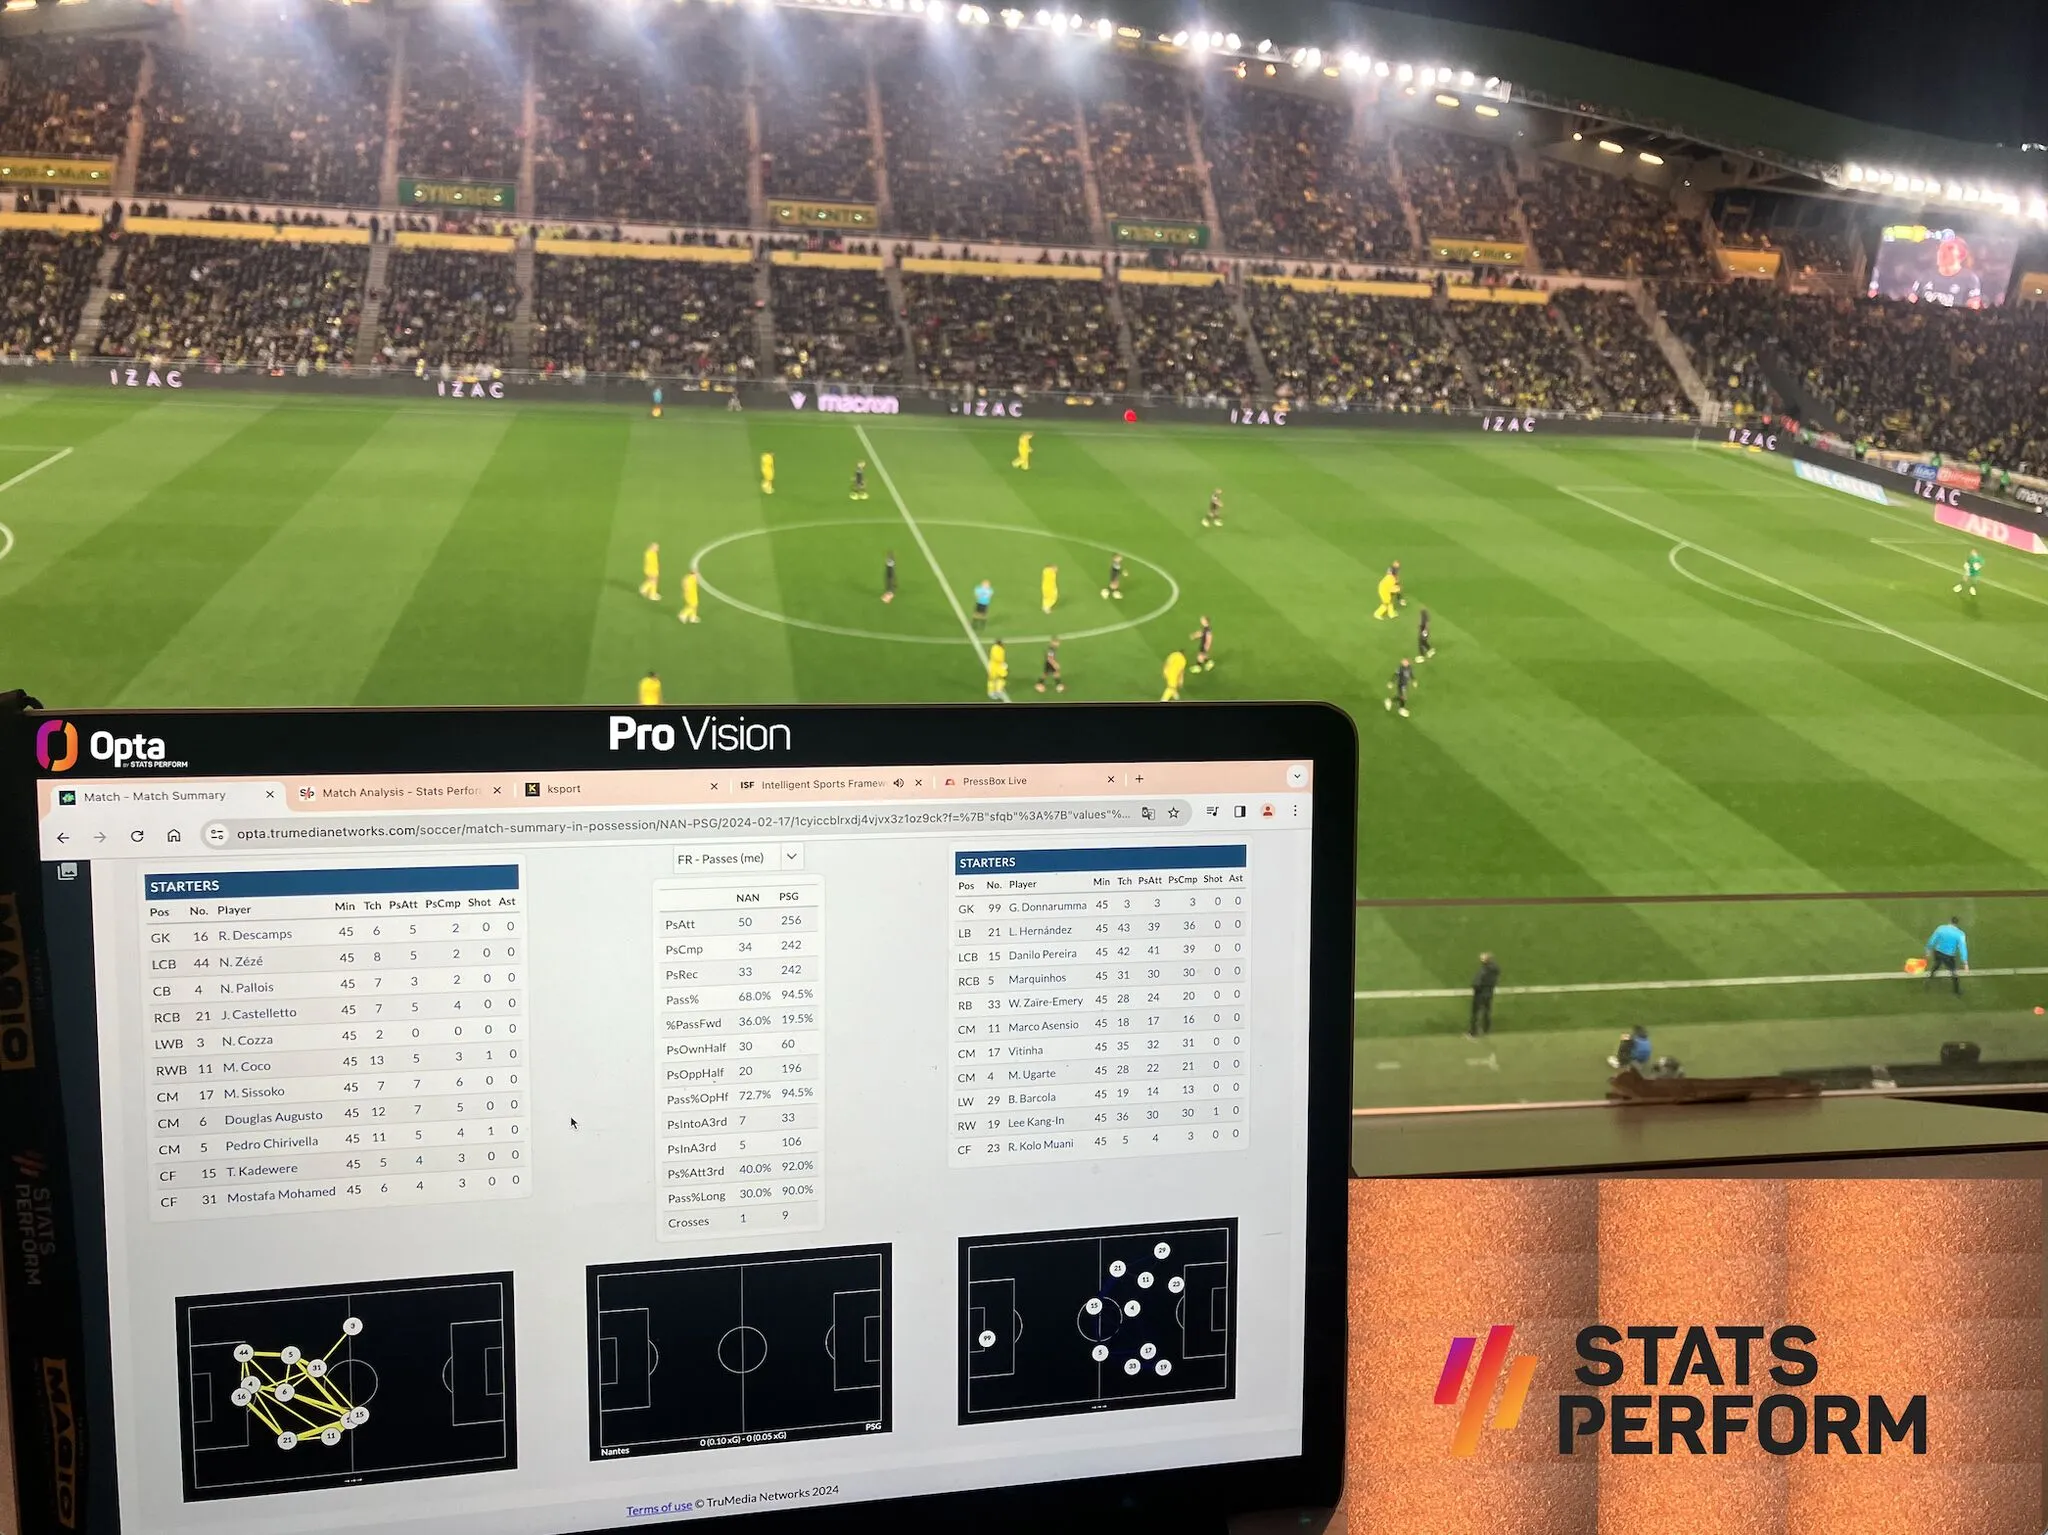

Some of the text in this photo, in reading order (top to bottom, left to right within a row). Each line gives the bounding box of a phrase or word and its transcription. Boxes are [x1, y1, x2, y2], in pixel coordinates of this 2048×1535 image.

[110, 369, 182, 388] IZAC
[437, 380, 504, 398] IZAC
[818, 394, 899, 413] macron
[963, 401, 1023, 417] IZAC
[1230, 408, 1287, 426] IZAC
[1482, 416, 1536, 433] IZAC
[1729, 427, 1777, 451] IZAC
[1914, 480, 1960, 506] IZAC
[740, 781, 755, 789] ISF
[762, 780, 810, 791] Intelligent
[813, 780, 846, 790] Sports
[963, 777, 1027, 786] PressBox Live
[84, 791, 226, 802] Match Match Summary
[323, 788, 356, 797] Match
[359, 787, 404, 799] Analysis
[416, 787, 443, 796] Stats
[548, 785, 581, 795] ksport
[678, 852, 764, 865] FR Passes (me)
[960, 857, 1016, 868] STARTERS
[151, 880, 219, 893] STARTERS
[958, 874, 1243, 890] Pos No. Player Min Tch PsAtt PsCmp Shot Ast
[736, 891, 799, 903] NAN PSG
[150, 897, 516, 917] Pos No. Player Min Tch PsAtt PsCmp Shot Ast
[1009, 902, 1087, 912] G. Donnarumma
[665, 915, 802, 930] PsAtt 50 256
[219, 930, 292, 941] R. Descamps
[1009, 925, 1072, 936] L. Hernández
[665, 940, 802, 956] PsCmp 34 242
[1009, 949, 1077, 960] Danilo Pereira
[220, 956, 263, 967] N. Zézé
[666, 964, 802, 980] PsRec 33 242
[1009, 973, 1067, 985] Marquinhos
[220, 982, 274, 994] N. Pallois
[666, 988, 814, 1005] Pass% 68.0% 94.5%
[1008, 997, 1083, 1008] W. Zaïre-Emery
[221, 1008, 297, 1020] J. Castelletto
[666, 1013, 814, 1030] %PassFwd 36.0% 19.5%
[1009, 1020, 1079, 1032] Marco Asensio
[222, 1036, 273, 1047] N. Cozza
[666, 1039, 795, 1055] PsOwnHalf 30 60
[1008, 1046, 1043, 1056] Vitinha
[223, 1062, 271, 1072] M. Coco
[666, 1063, 802, 1079] PsOppHalf 20 196
[1008, 1070, 1056, 1081] M. Ugarte
[224, 1086, 285, 1099] M. Sissoko
[667, 1087, 814, 1105] Pass%OpHf 72.7% 94.5%
[1008, 1092, 1056, 1104] B. Barcola
[225, 1111, 323, 1126] Douglas Augusto
[667, 1116, 727, 1130] PsIntoA3rd
[1008, 1116, 1064, 1128] Lee Kang-In
[226, 1136, 318, 1151] Pedro Chirivella
[667, 1141, 717, 1155] PsInA3rd
[1008, 1139, 1074, 1152] R. Kolo Muani
[225, 1165, 298, 1177] T. Kadewere
[668, 1160, 814, 1179] Ps%Att3rd 40.0% 92.0%
[227, 1186, 336, 1203] Mostafa Mohamed
[668, 1184, 814, 1204] Pass%Long 30.0% 90.0%
[33, 1188, 57, 1257] STATS
[668, 1218, 710, 1229] Crosses
[15, 1184, 43, 1287] PERFORM
[864, 1421, 882, 1431] PSG
[705, 1436, 727, 1447] (0.10
[727, 1436, 741, 1444] xG)
[753, 1433, 773, 1442] (0.05
[773, 1431, 787, 1440] xG)
[601, 1448, 630, 1456] Nantes
[626, 1485, 839, 1516] Terms of use TruMedia Networks 2024
